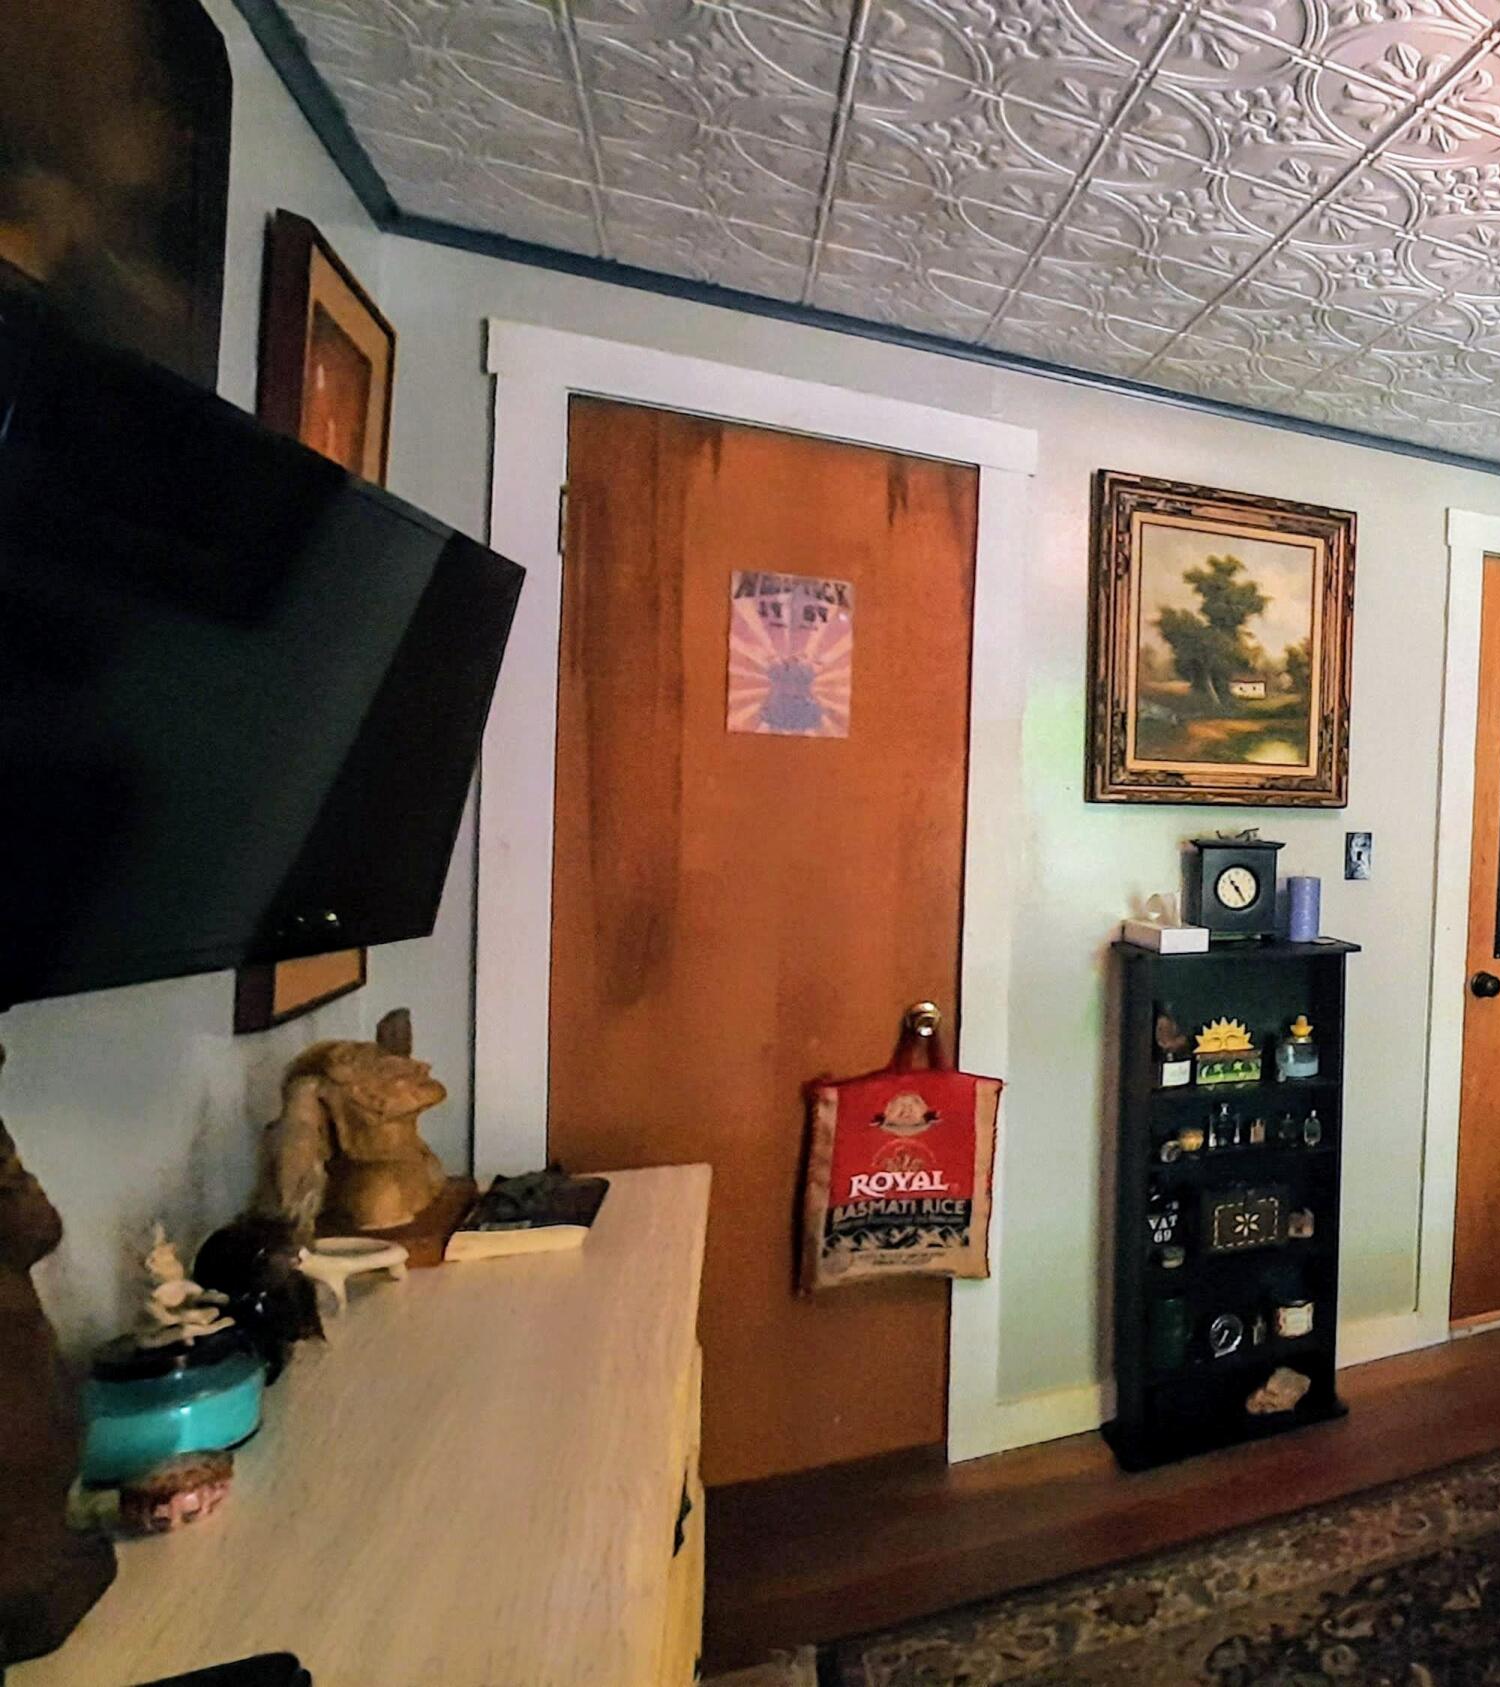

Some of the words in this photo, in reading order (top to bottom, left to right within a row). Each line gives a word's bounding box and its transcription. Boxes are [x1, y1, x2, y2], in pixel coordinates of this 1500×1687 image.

[849, 1170, 950, 1198] ROYAL
[922, 1198, 966, 1215] RICE
[1147, 1214, 1178, 1230] VAT
[1153, 1229, 1172, 1243] 69
